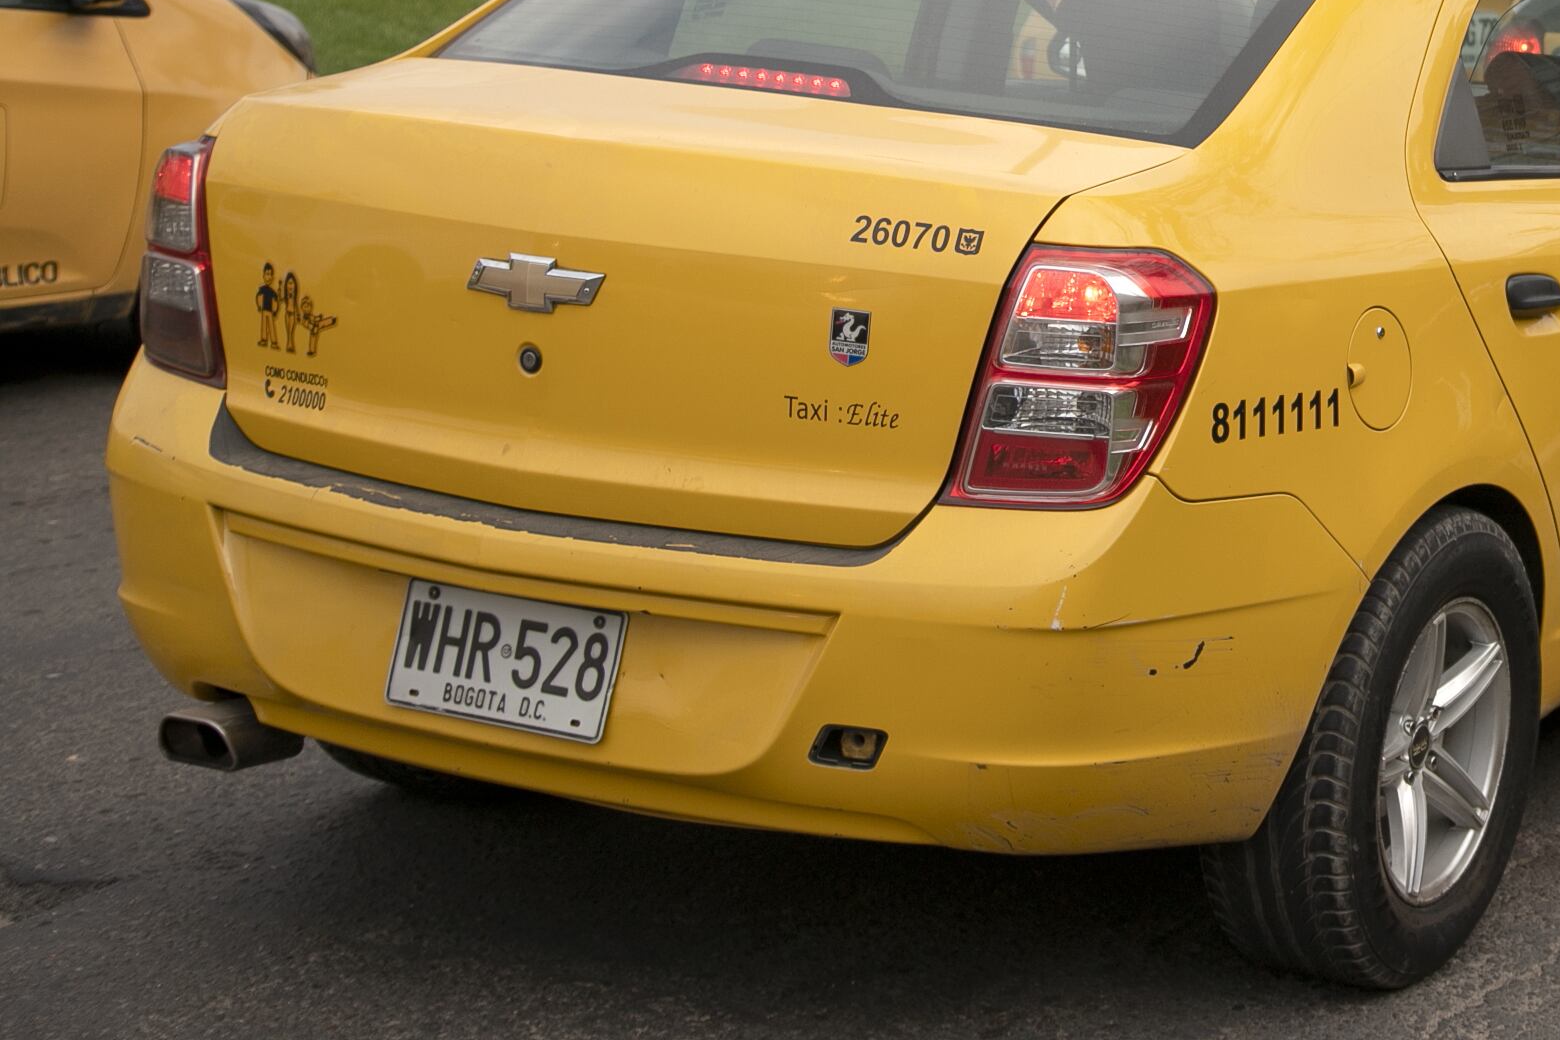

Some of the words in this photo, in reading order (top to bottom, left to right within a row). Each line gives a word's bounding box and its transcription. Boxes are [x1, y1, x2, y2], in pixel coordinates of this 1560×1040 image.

[850, 215, 951, 253] 26070
[0, 260, 58, 287] LICO
[845, 348, 866, 356] JORGE
[264, 365, 286, 380] COMO
[278, 385, 327, 411] 2100000
[783, 395, 829, 422] Taxi
[1211, 388, 1340, 444] 8111111
[403, 599, 502, 684] WHR
[511, 619, 609, 703] 528
[442, 682, 507, 714] BOGOTA
[518, 696, 547, 722] D.C.
